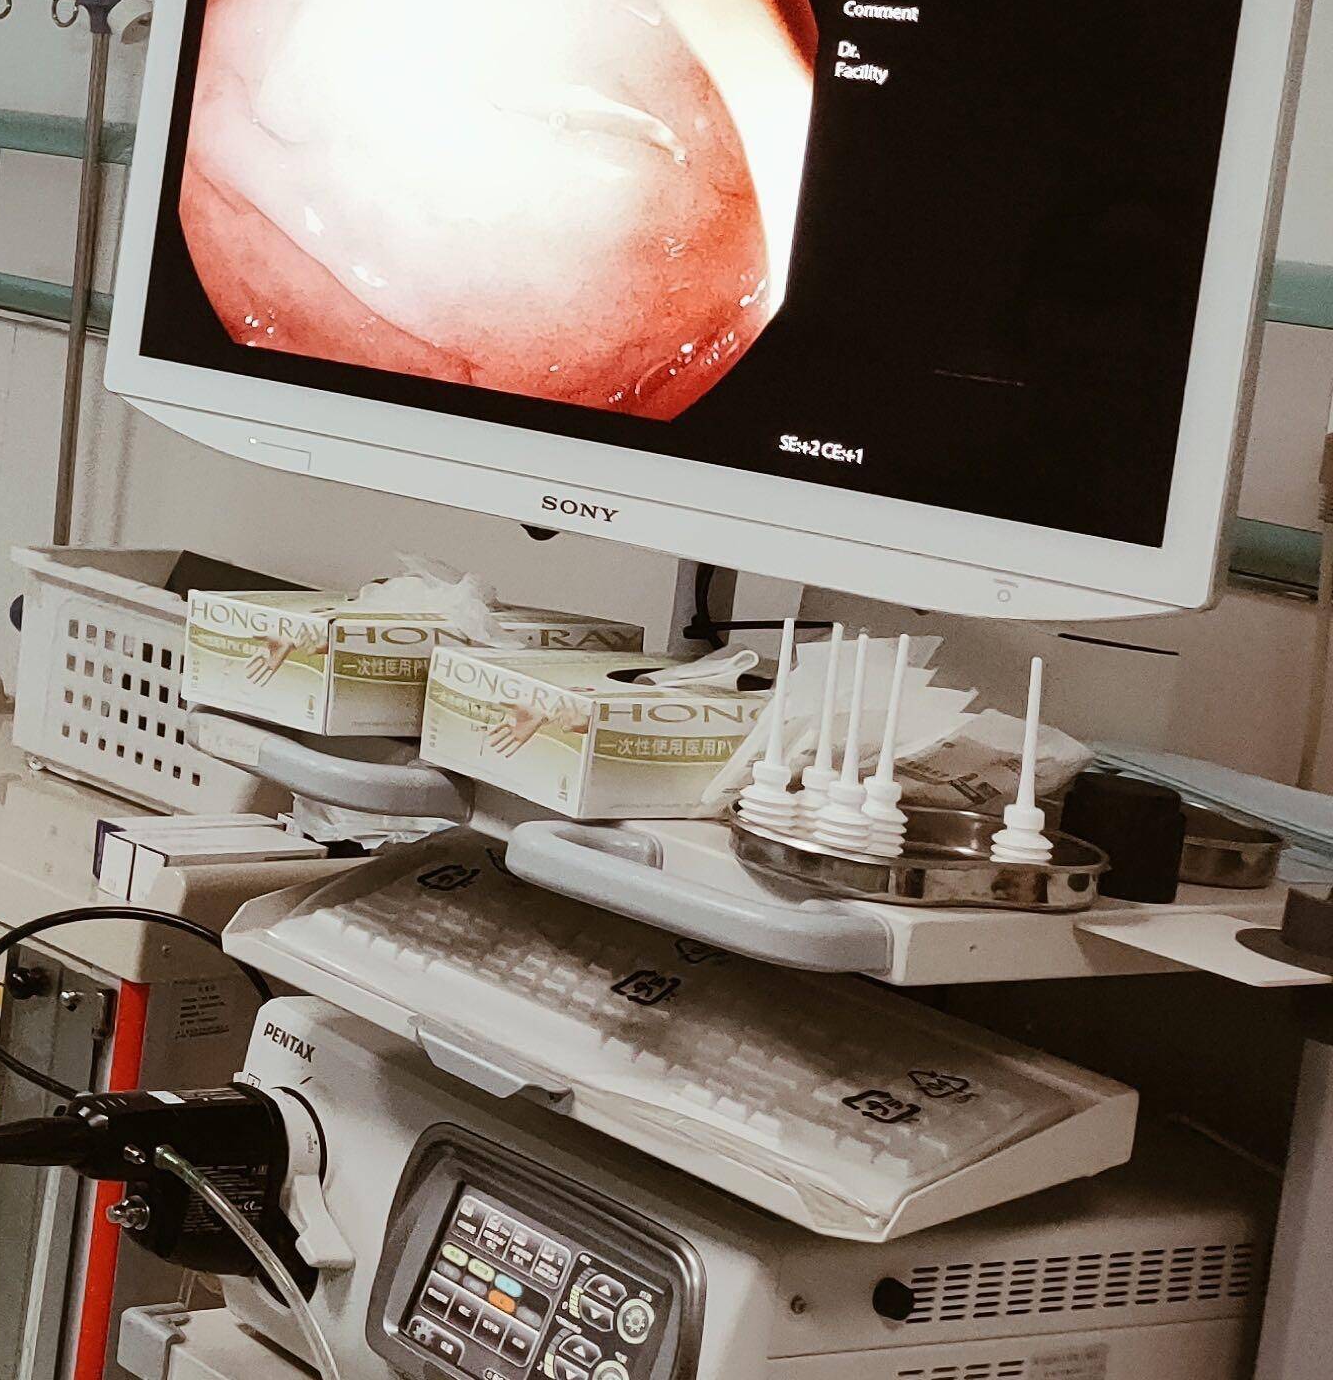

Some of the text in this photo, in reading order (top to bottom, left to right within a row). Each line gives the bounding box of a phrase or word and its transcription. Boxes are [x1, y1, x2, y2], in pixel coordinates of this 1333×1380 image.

[842, 0, 920, 23] Comment
[837, 40, 861, 60] Dr.
[834, 61, 889, 86] Facility
[541, 495, 620, 523] SONY
[263, 1022, 316, 1063] PENTAX
